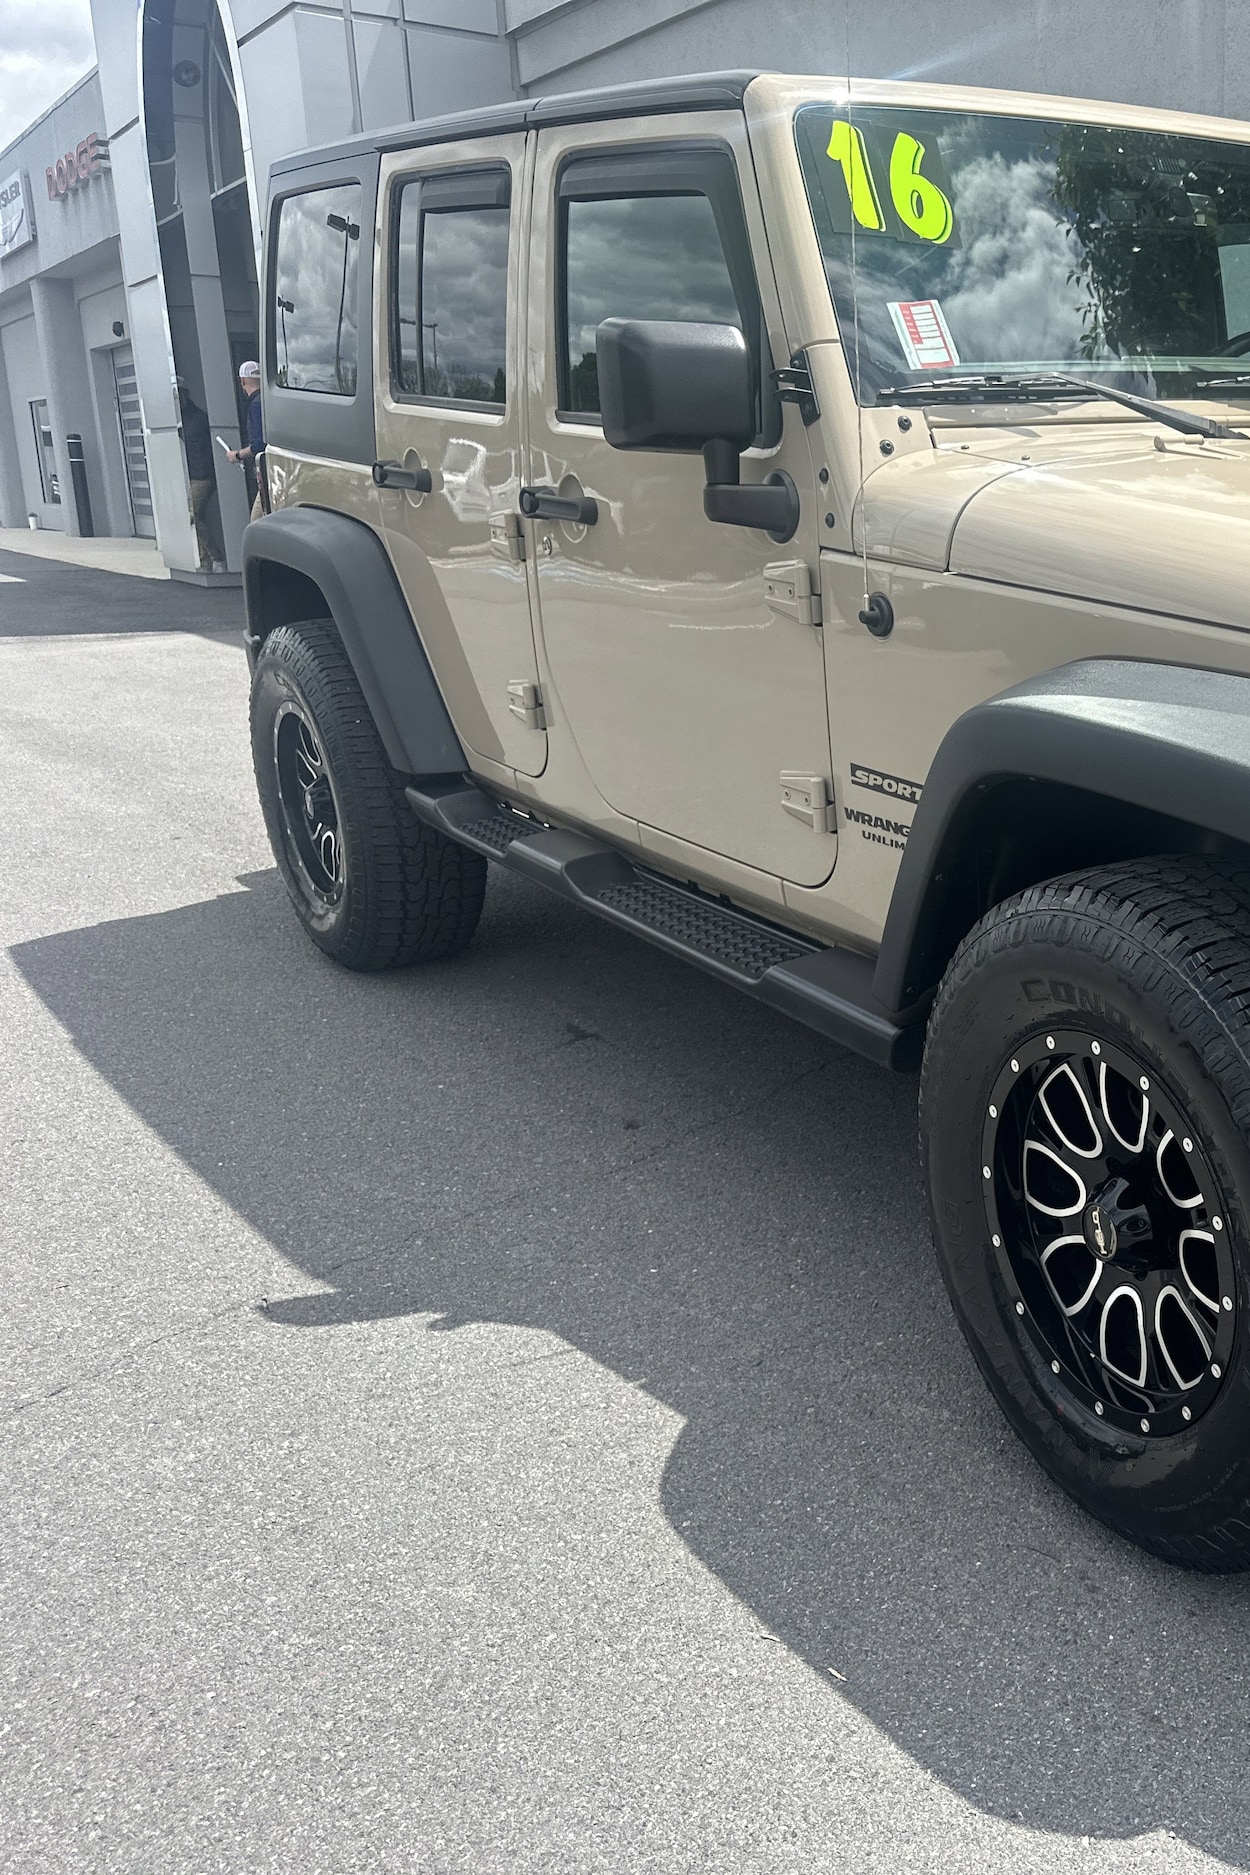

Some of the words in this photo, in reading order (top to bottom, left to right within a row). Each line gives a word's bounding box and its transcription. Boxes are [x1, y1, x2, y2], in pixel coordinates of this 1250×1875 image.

[46, 132, 100, 201] DODGE
[826, 120, 953, 244] 16
[0, 181, 21, 209] SLER
[854, 770, 923, 801] SPORT
